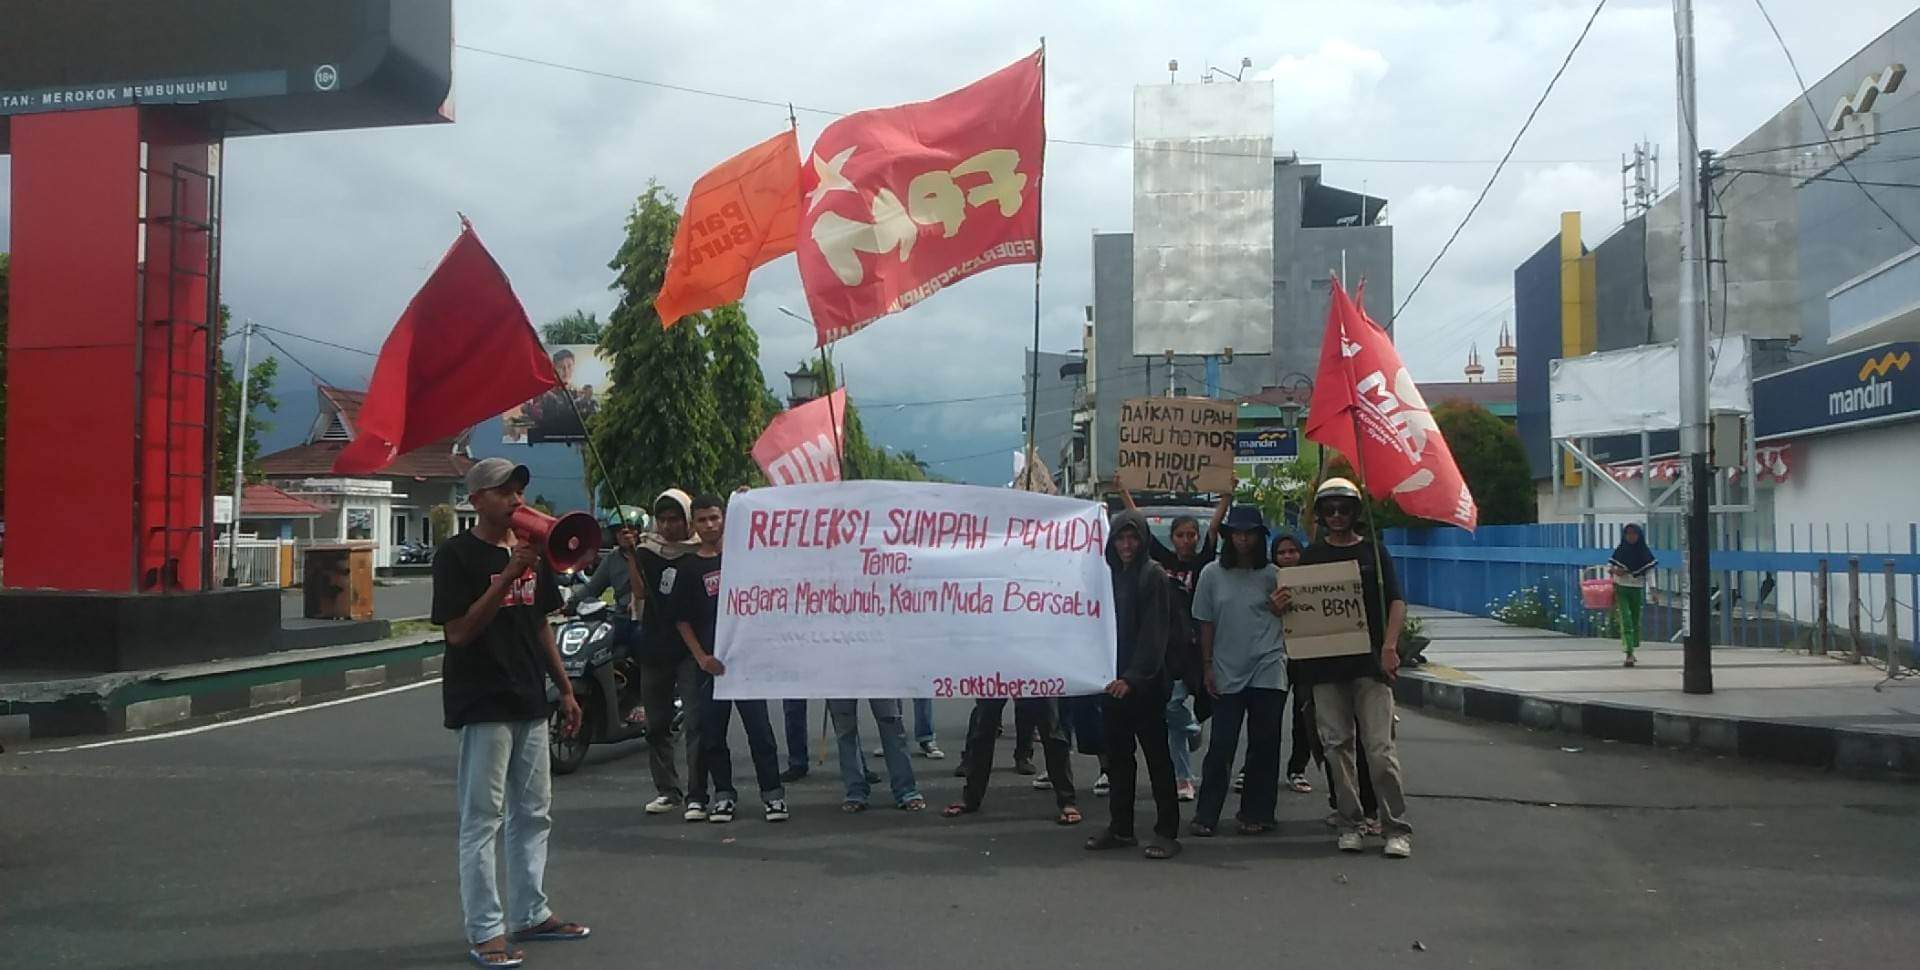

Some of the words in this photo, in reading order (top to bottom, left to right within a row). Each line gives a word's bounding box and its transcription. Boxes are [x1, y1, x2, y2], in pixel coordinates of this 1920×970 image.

[42, 88, 116, 104] MEROKOK
[123, 79, 228, 97] MEMBUNUHMU
[1829, 376, 1893, 416] mandiri
[1191, 409, 1232, 425] UPAH
[1120, 426, 1164, 445] GURU
[1155, 452, 1210, 472] HIDUP
[748, 508, 870, 550] REFLEKSI
[883, 509, 988, 549] SUMPAH
[1003, 517, 1104, 556] PEMUDA
[860, 548, 912, 576] Tema:
[726, 585, 788, 616] Negara
[795, 581, 886, 616] Membunuh,
[889, 582, 937, 615] Kaum
[941, 581, 993, 615] Muda
[1003, 581, 1100, 618] Bersatu
[1322, 599, 1361, 618] BBM
